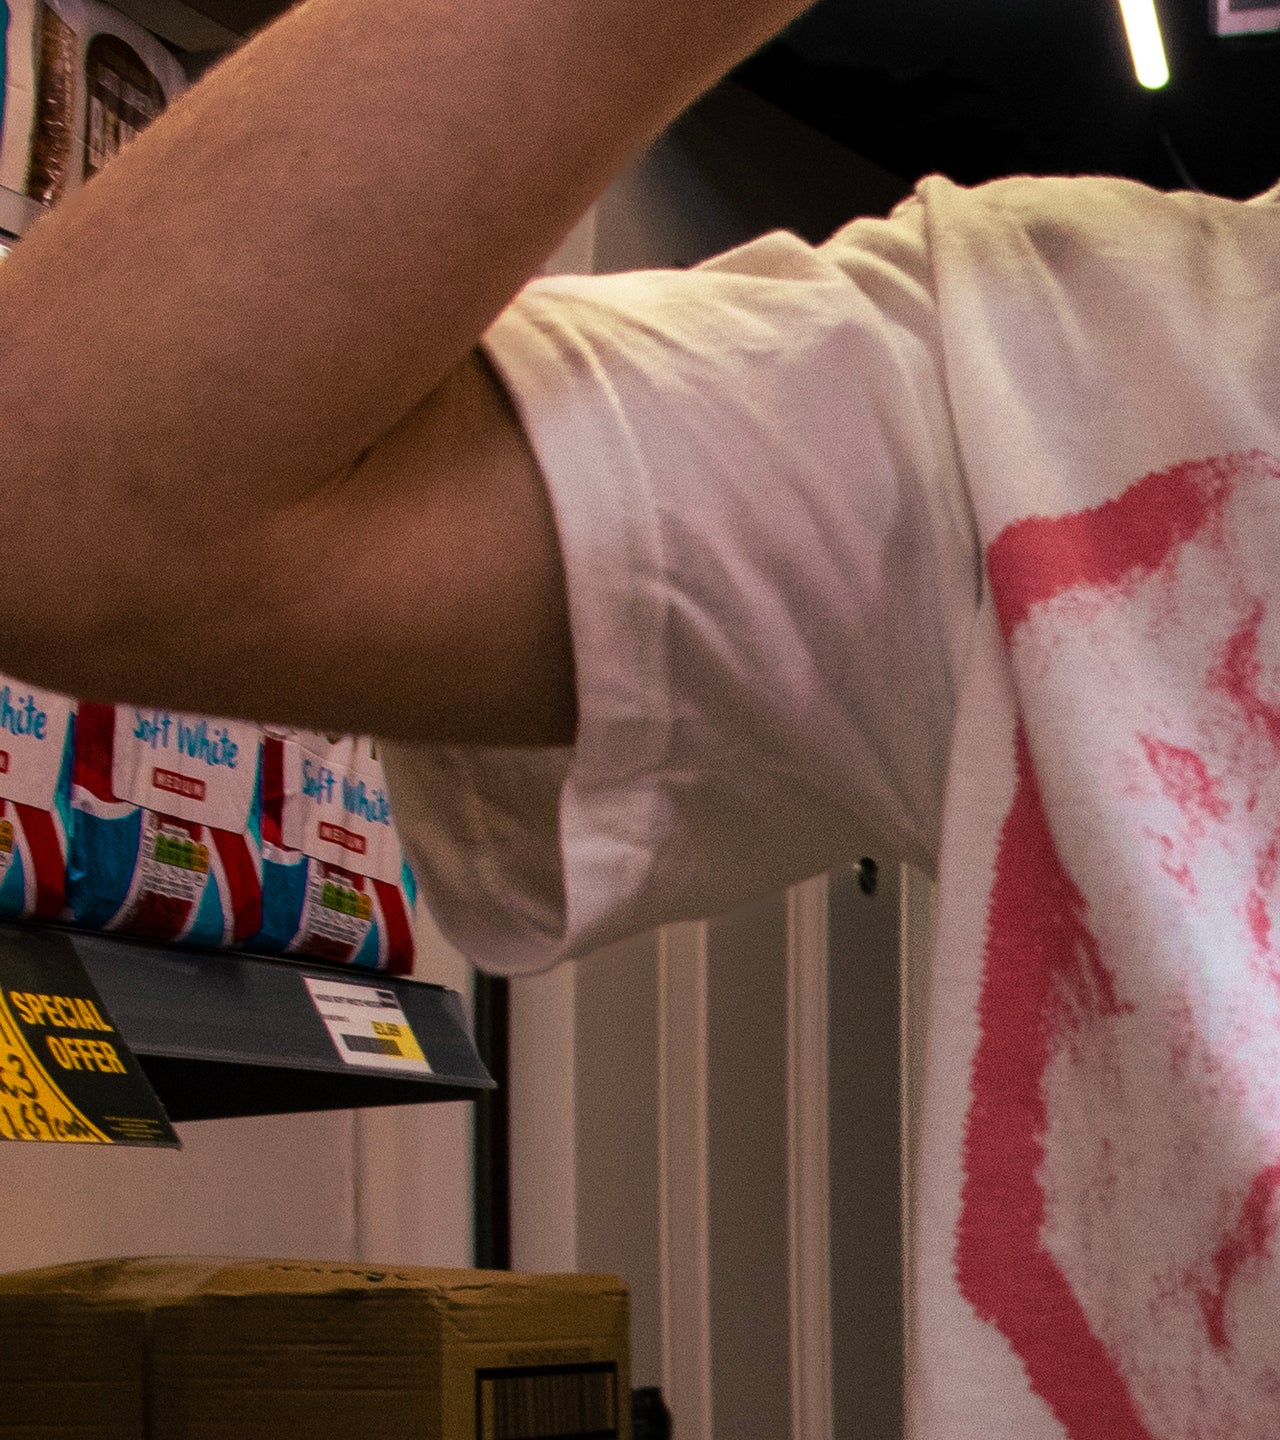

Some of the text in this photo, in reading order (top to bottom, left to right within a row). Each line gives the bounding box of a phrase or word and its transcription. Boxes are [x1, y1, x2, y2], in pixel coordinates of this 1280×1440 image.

[177, 715, 238, 768] White
[7, 990, 116, 1033] SPECIAL
[44, 1034, 129, 1074] OFFER
